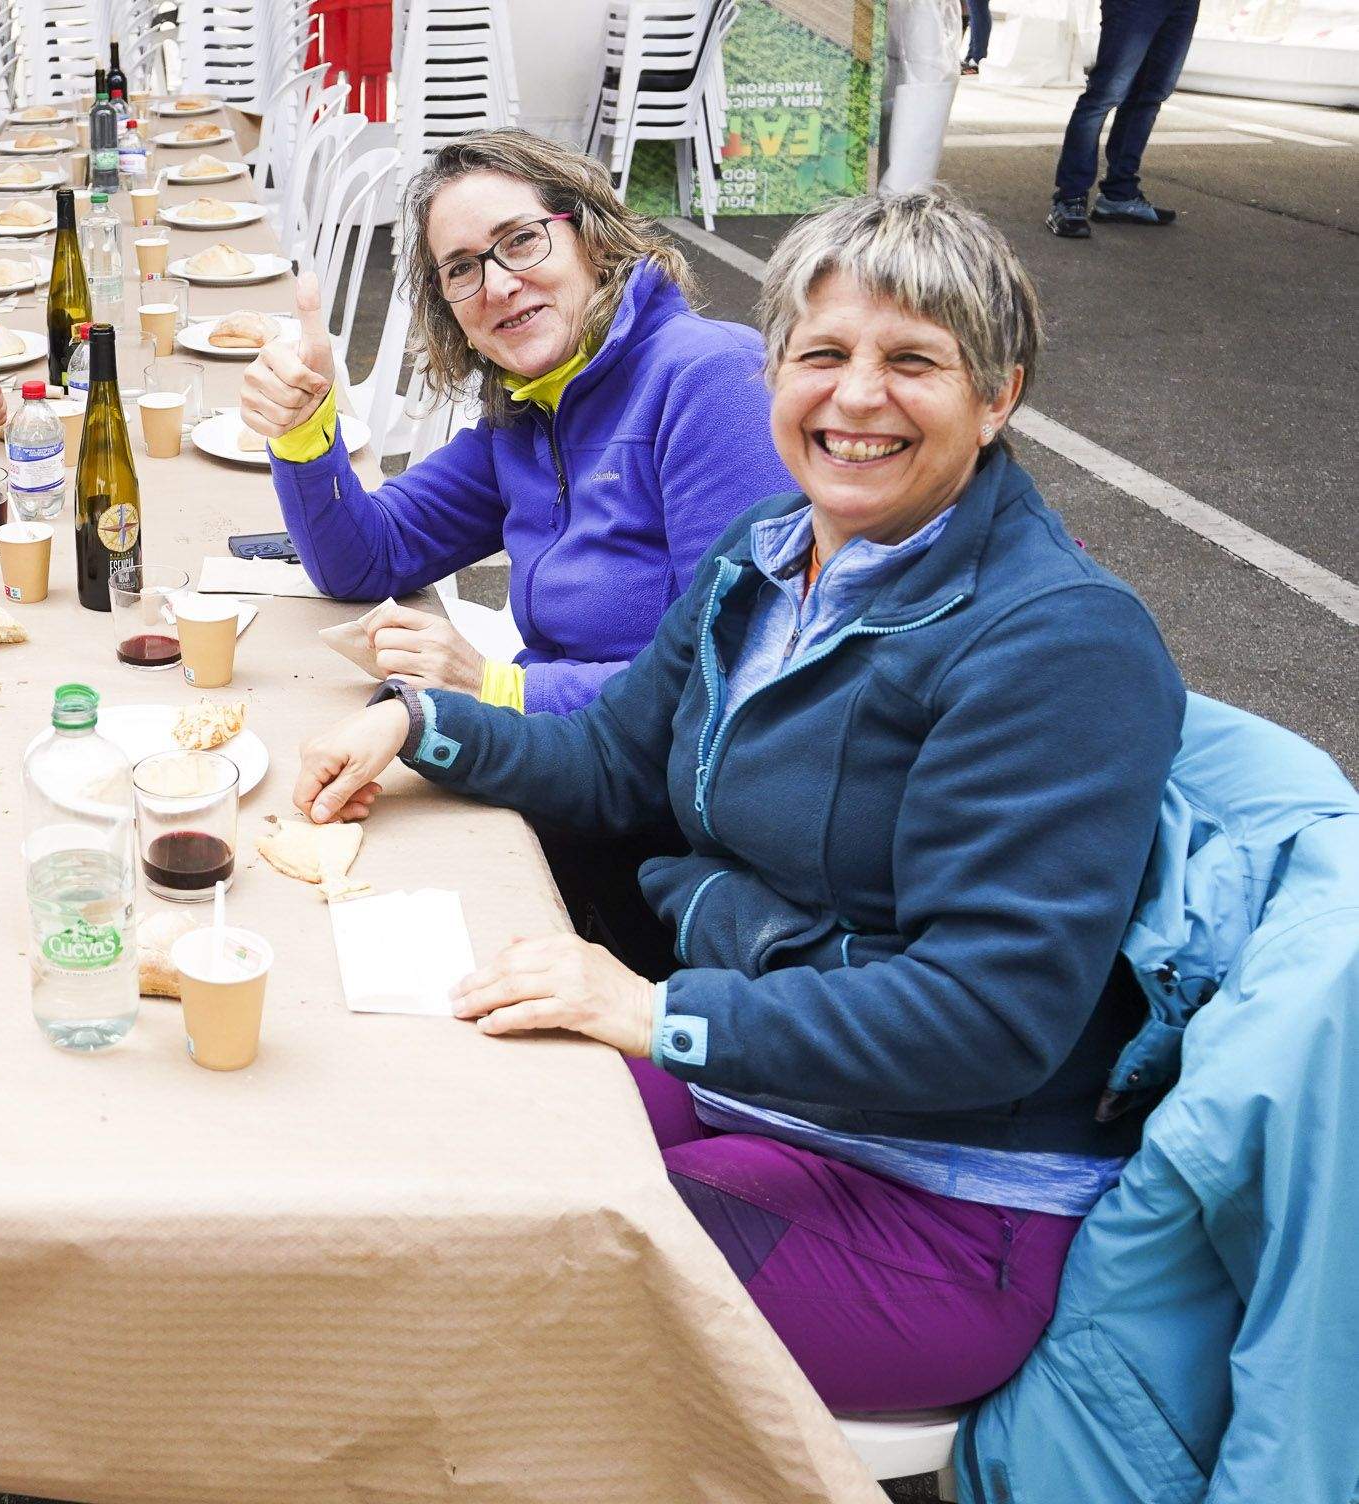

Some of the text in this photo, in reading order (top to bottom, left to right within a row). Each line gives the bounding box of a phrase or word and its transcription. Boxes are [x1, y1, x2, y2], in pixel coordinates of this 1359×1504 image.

[727, 80, 823, 94] TRANSFRONT
[781, 95, 823, 108] FEIRA
[720, 110, 822, 158] FAT
[48, 935, 117, 958] Cuevas
